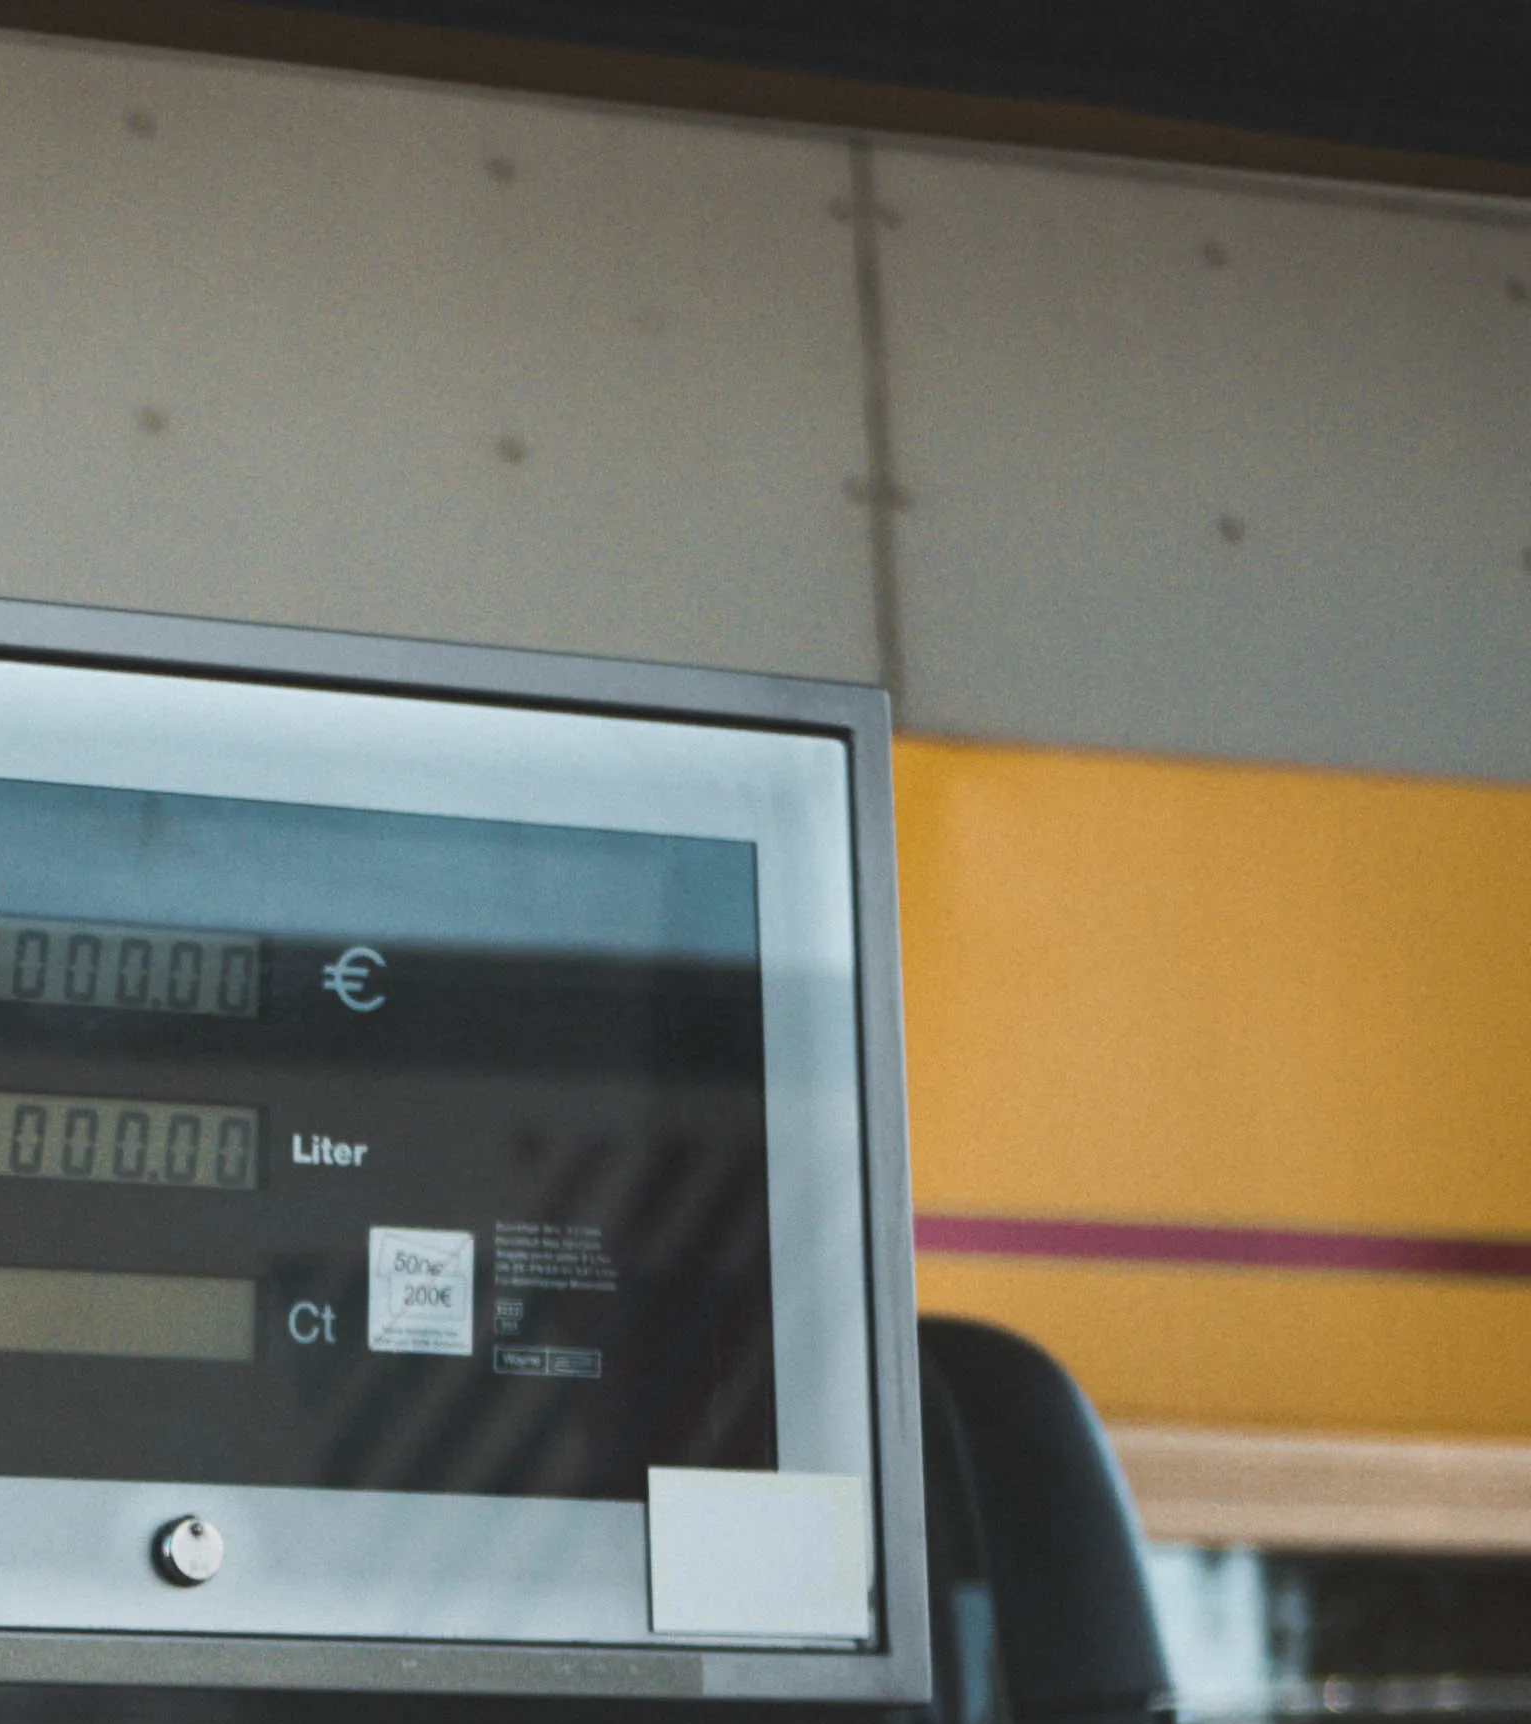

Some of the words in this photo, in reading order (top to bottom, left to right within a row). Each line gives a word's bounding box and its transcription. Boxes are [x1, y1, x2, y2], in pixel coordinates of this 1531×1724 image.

[322, 946, 386, 1012] €
[293, 1133, 368, 1169] Liter
[288, 1301, 336, 1345] Ct
